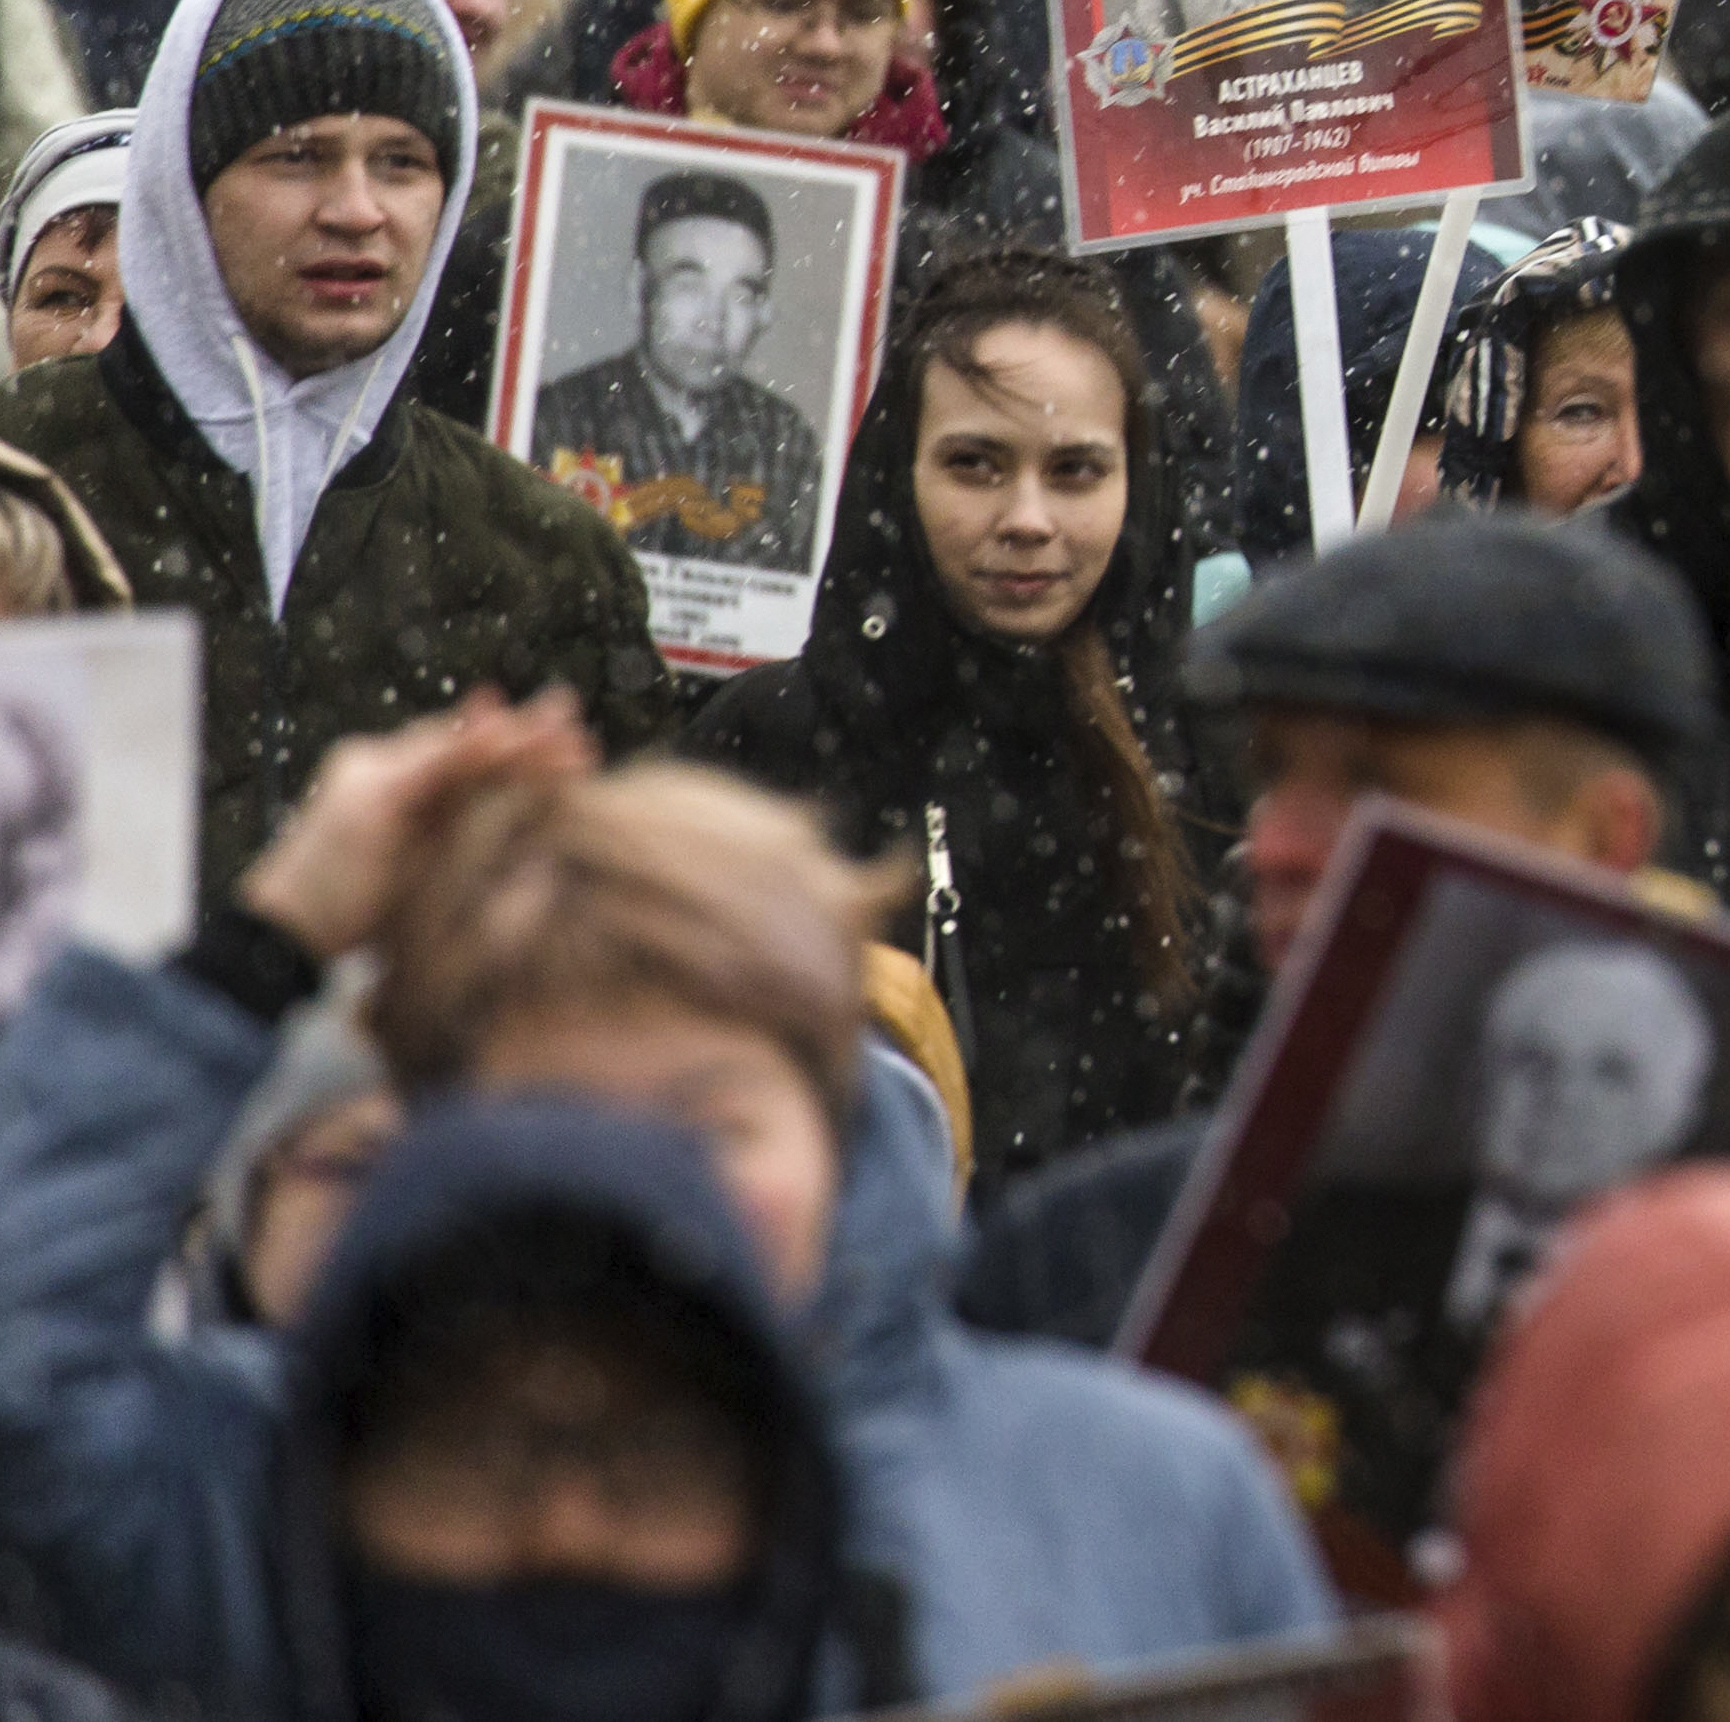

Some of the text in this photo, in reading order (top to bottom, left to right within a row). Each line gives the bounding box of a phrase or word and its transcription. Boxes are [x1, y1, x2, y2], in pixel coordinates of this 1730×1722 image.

[1218, 60, 1363, 104] АСТРАХАНЦЕВ
[1193, 93, 1395, 139] Василий Павлович
